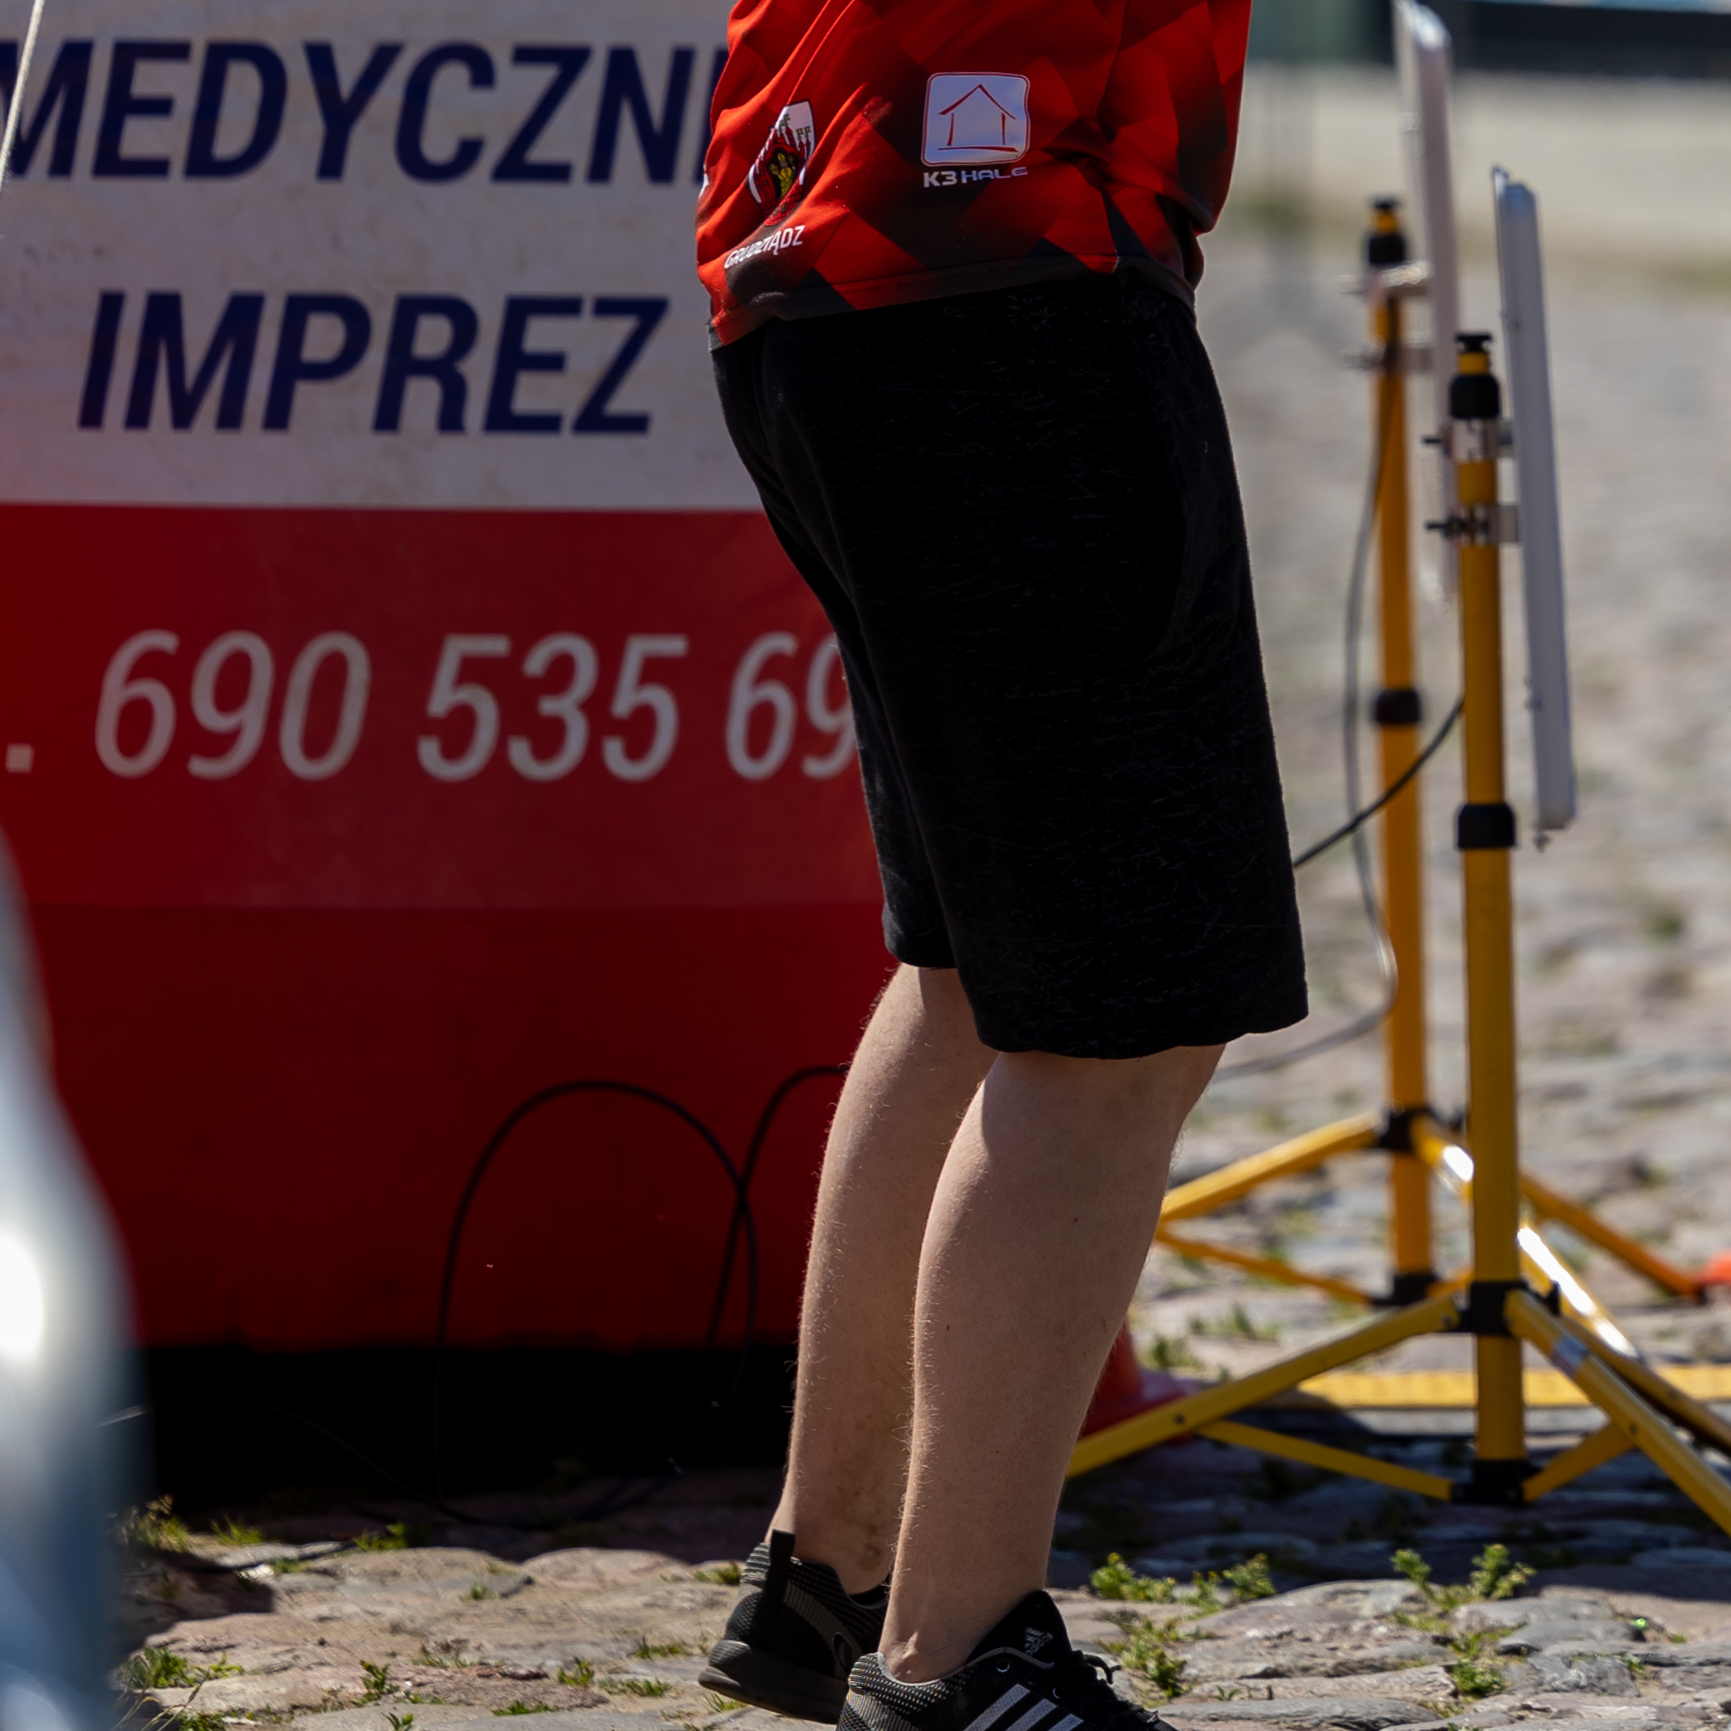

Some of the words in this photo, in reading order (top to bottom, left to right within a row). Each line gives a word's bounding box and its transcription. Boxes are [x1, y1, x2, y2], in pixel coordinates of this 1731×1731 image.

[923, 170, 958, 188] K3
[960, 166, 1029, 184] HALE
[77, 290, 670, 435] IMPREZ
[94, 629, 371, 781] 690
[416, 632, 690, 782] 535
